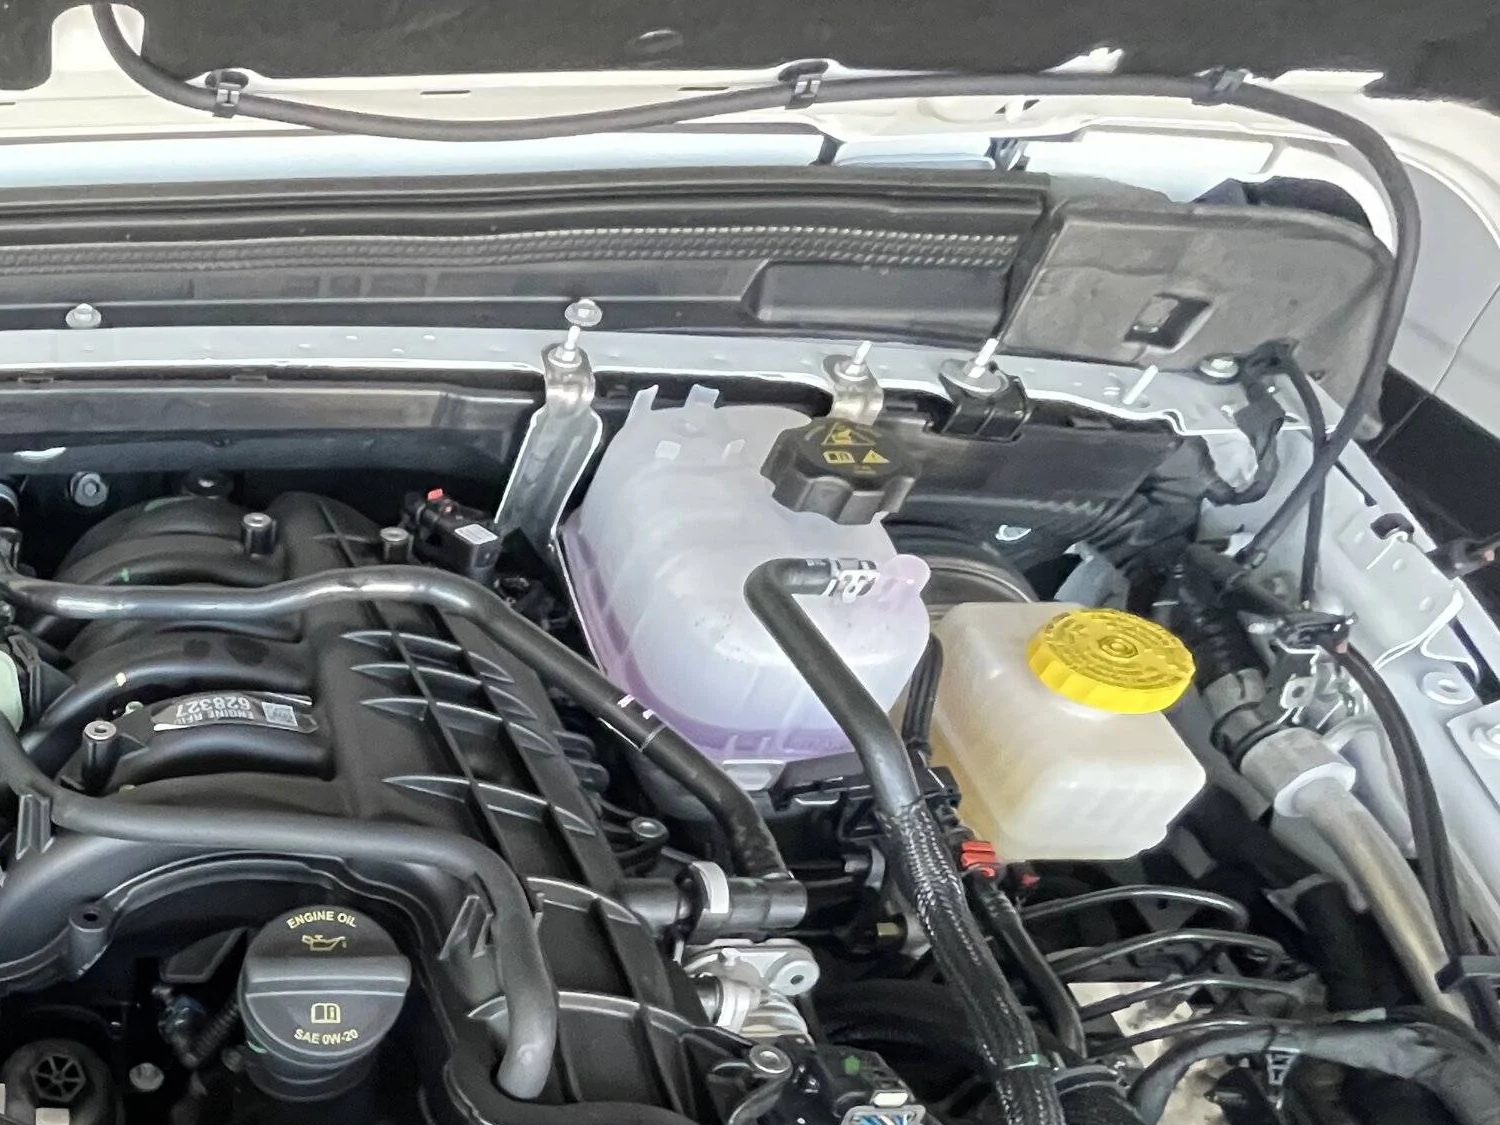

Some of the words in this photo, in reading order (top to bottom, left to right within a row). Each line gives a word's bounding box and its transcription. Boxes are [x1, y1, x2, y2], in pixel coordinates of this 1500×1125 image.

[176, 697, 251, 717] 628327
[209, 709, 254, 720] ENGINE
[286, 910, 335, 930] ENGINE
[337, 912, 357, 928] OIL
[293, 1028, 320, 1045] SAE
[322, 1028, 359, 1045] 0W-20
